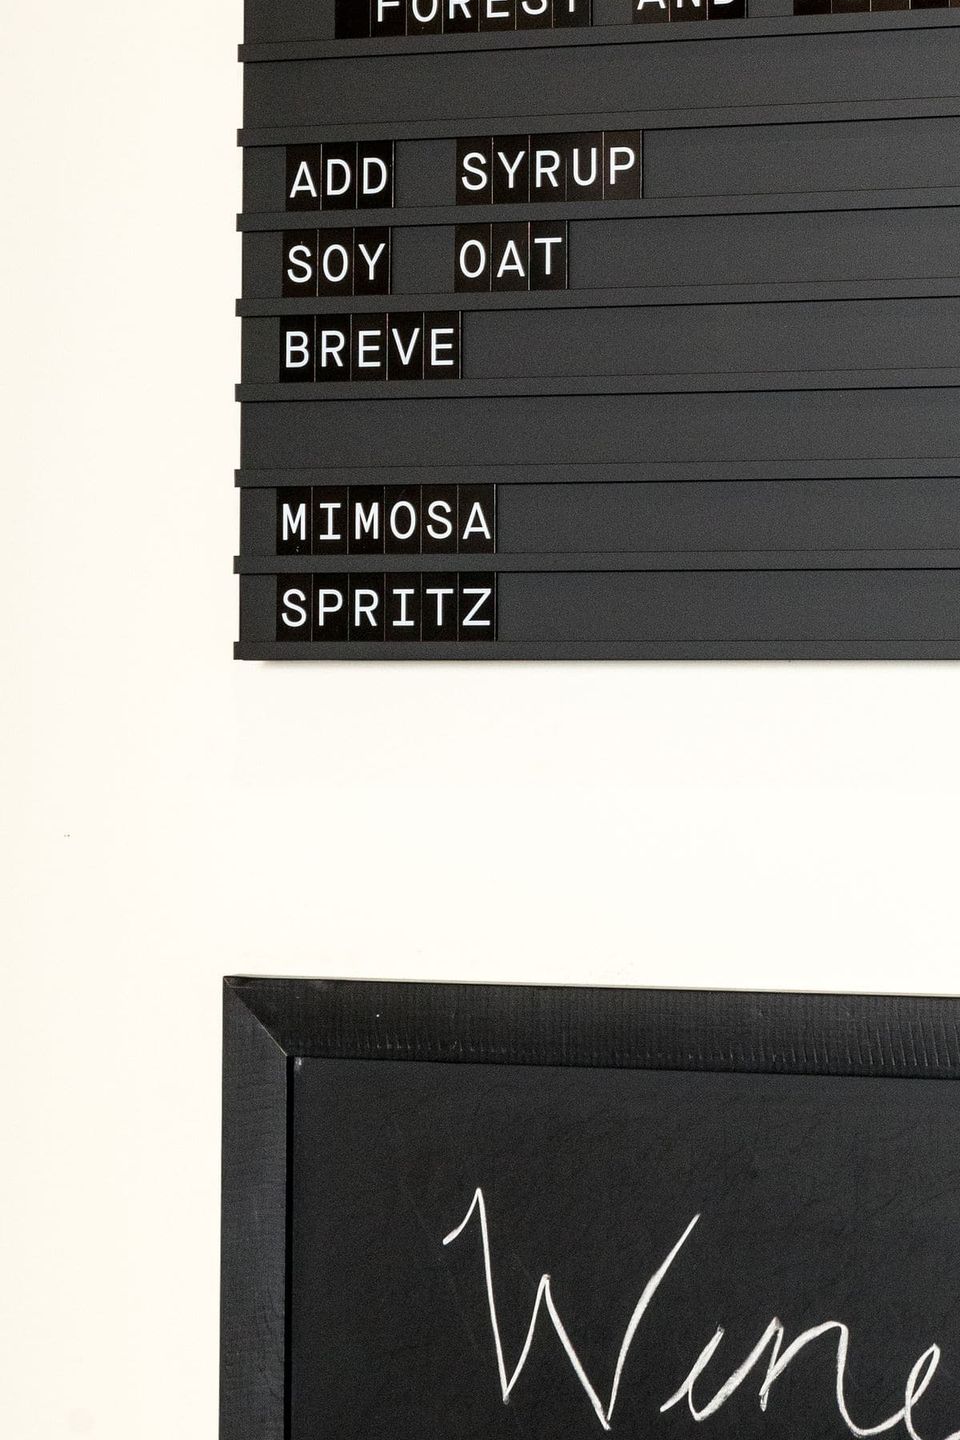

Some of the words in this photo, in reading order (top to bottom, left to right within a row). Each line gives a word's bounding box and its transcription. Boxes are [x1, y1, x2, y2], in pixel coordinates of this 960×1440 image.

[289, 156, 387, 198] ADD
[461, 146, 635, 191] SYRUP
[287, 243, 386, 283] SOY
[459, 237, 563, 279] OAT
[285, 327, 454, 368] BREVE
[282, 500, 491, 541] MIMOSA
[281, 588, 492, 628] SPRITZ
